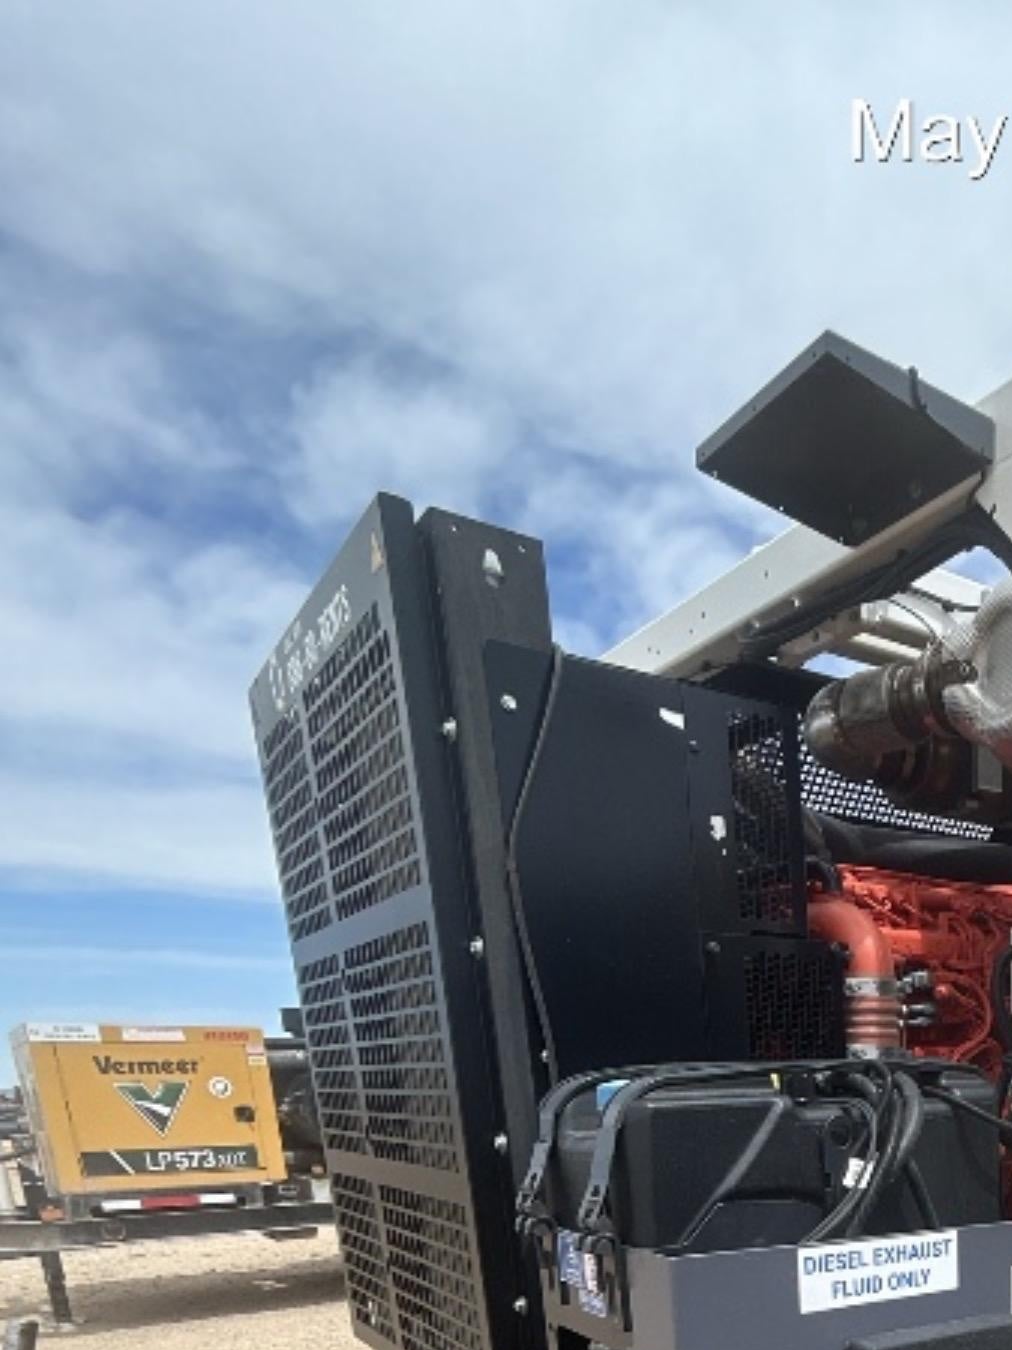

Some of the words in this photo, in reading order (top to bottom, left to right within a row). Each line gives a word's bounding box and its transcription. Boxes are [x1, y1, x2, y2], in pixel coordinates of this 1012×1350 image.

[93, 1055, 199, 1075] Vermeer
[803, 1250, 867, 1275] DIESEL
[873, 1239, 952, 1264] EXHAUST
[831, 1276, 884, 1300] FLUID
[888, 1269, 931, 1291] ONLY
